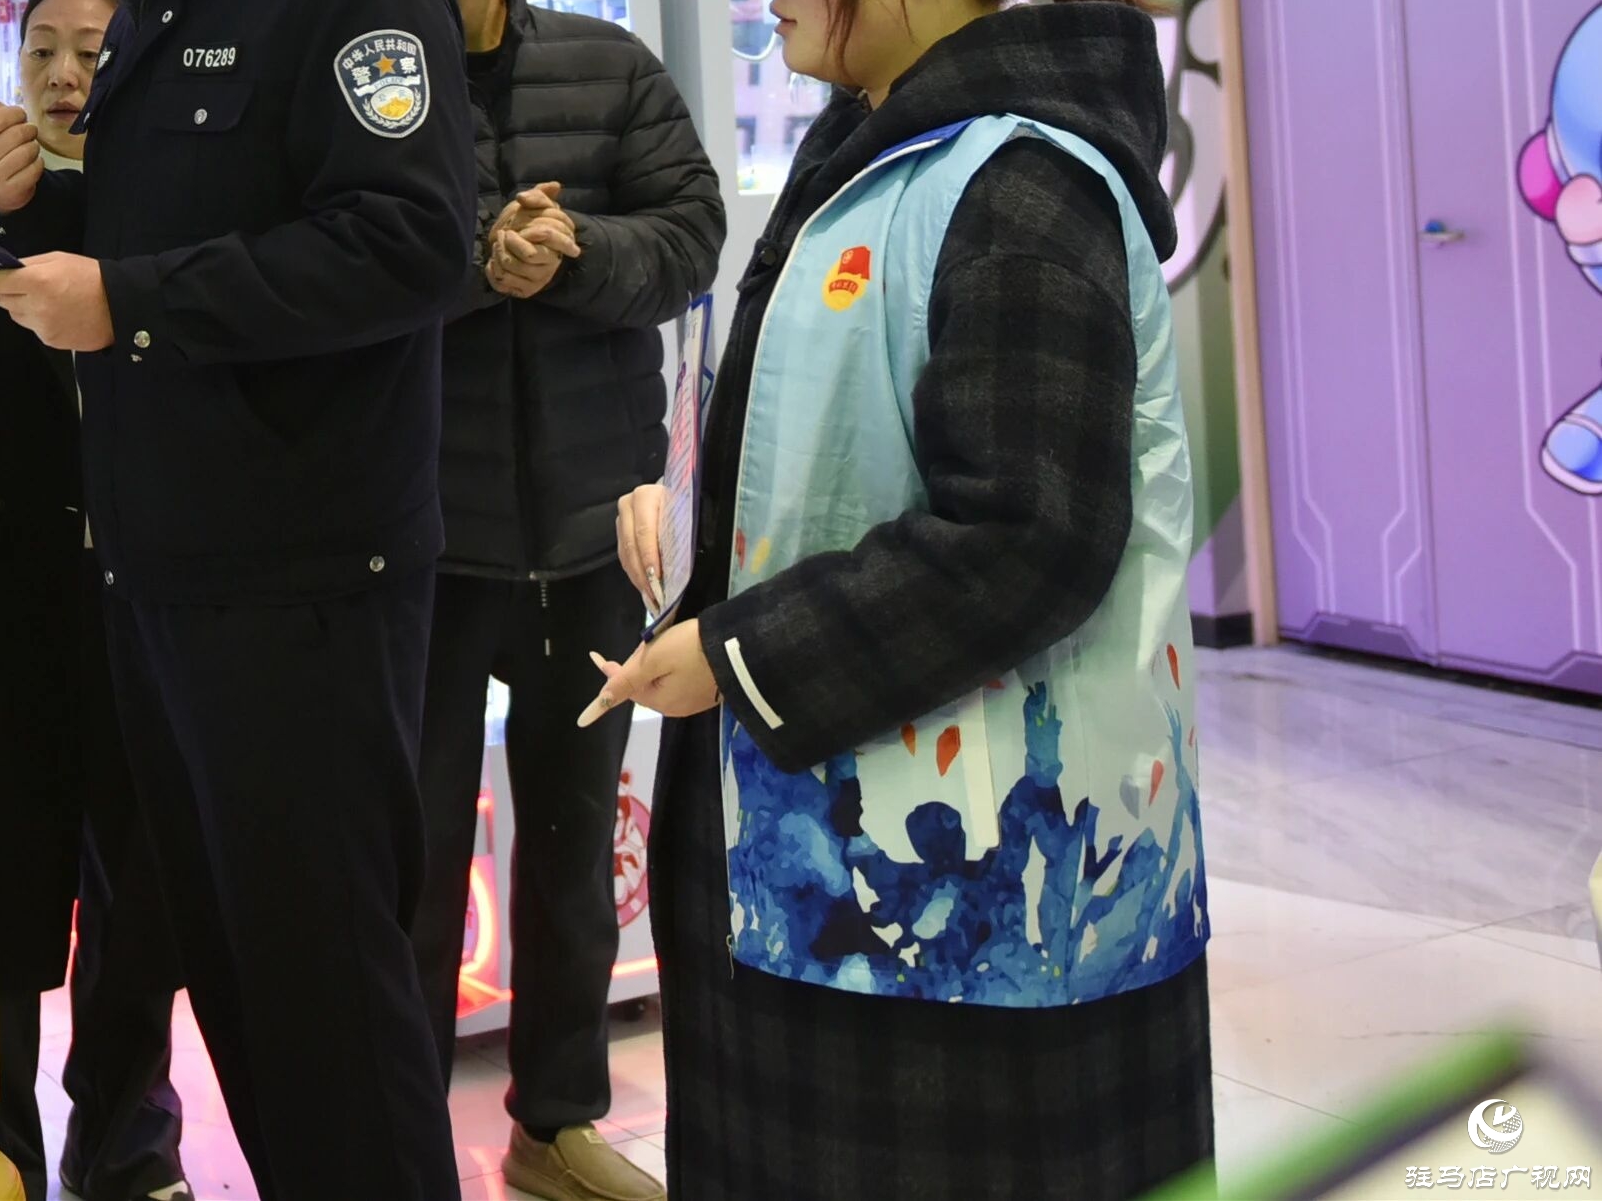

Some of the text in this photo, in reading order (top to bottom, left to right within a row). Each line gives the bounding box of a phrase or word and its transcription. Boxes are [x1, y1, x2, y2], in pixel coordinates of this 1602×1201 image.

[183, 47, 236, 68] 076289
[342, 38, 417, 70] 中华人民共和国
